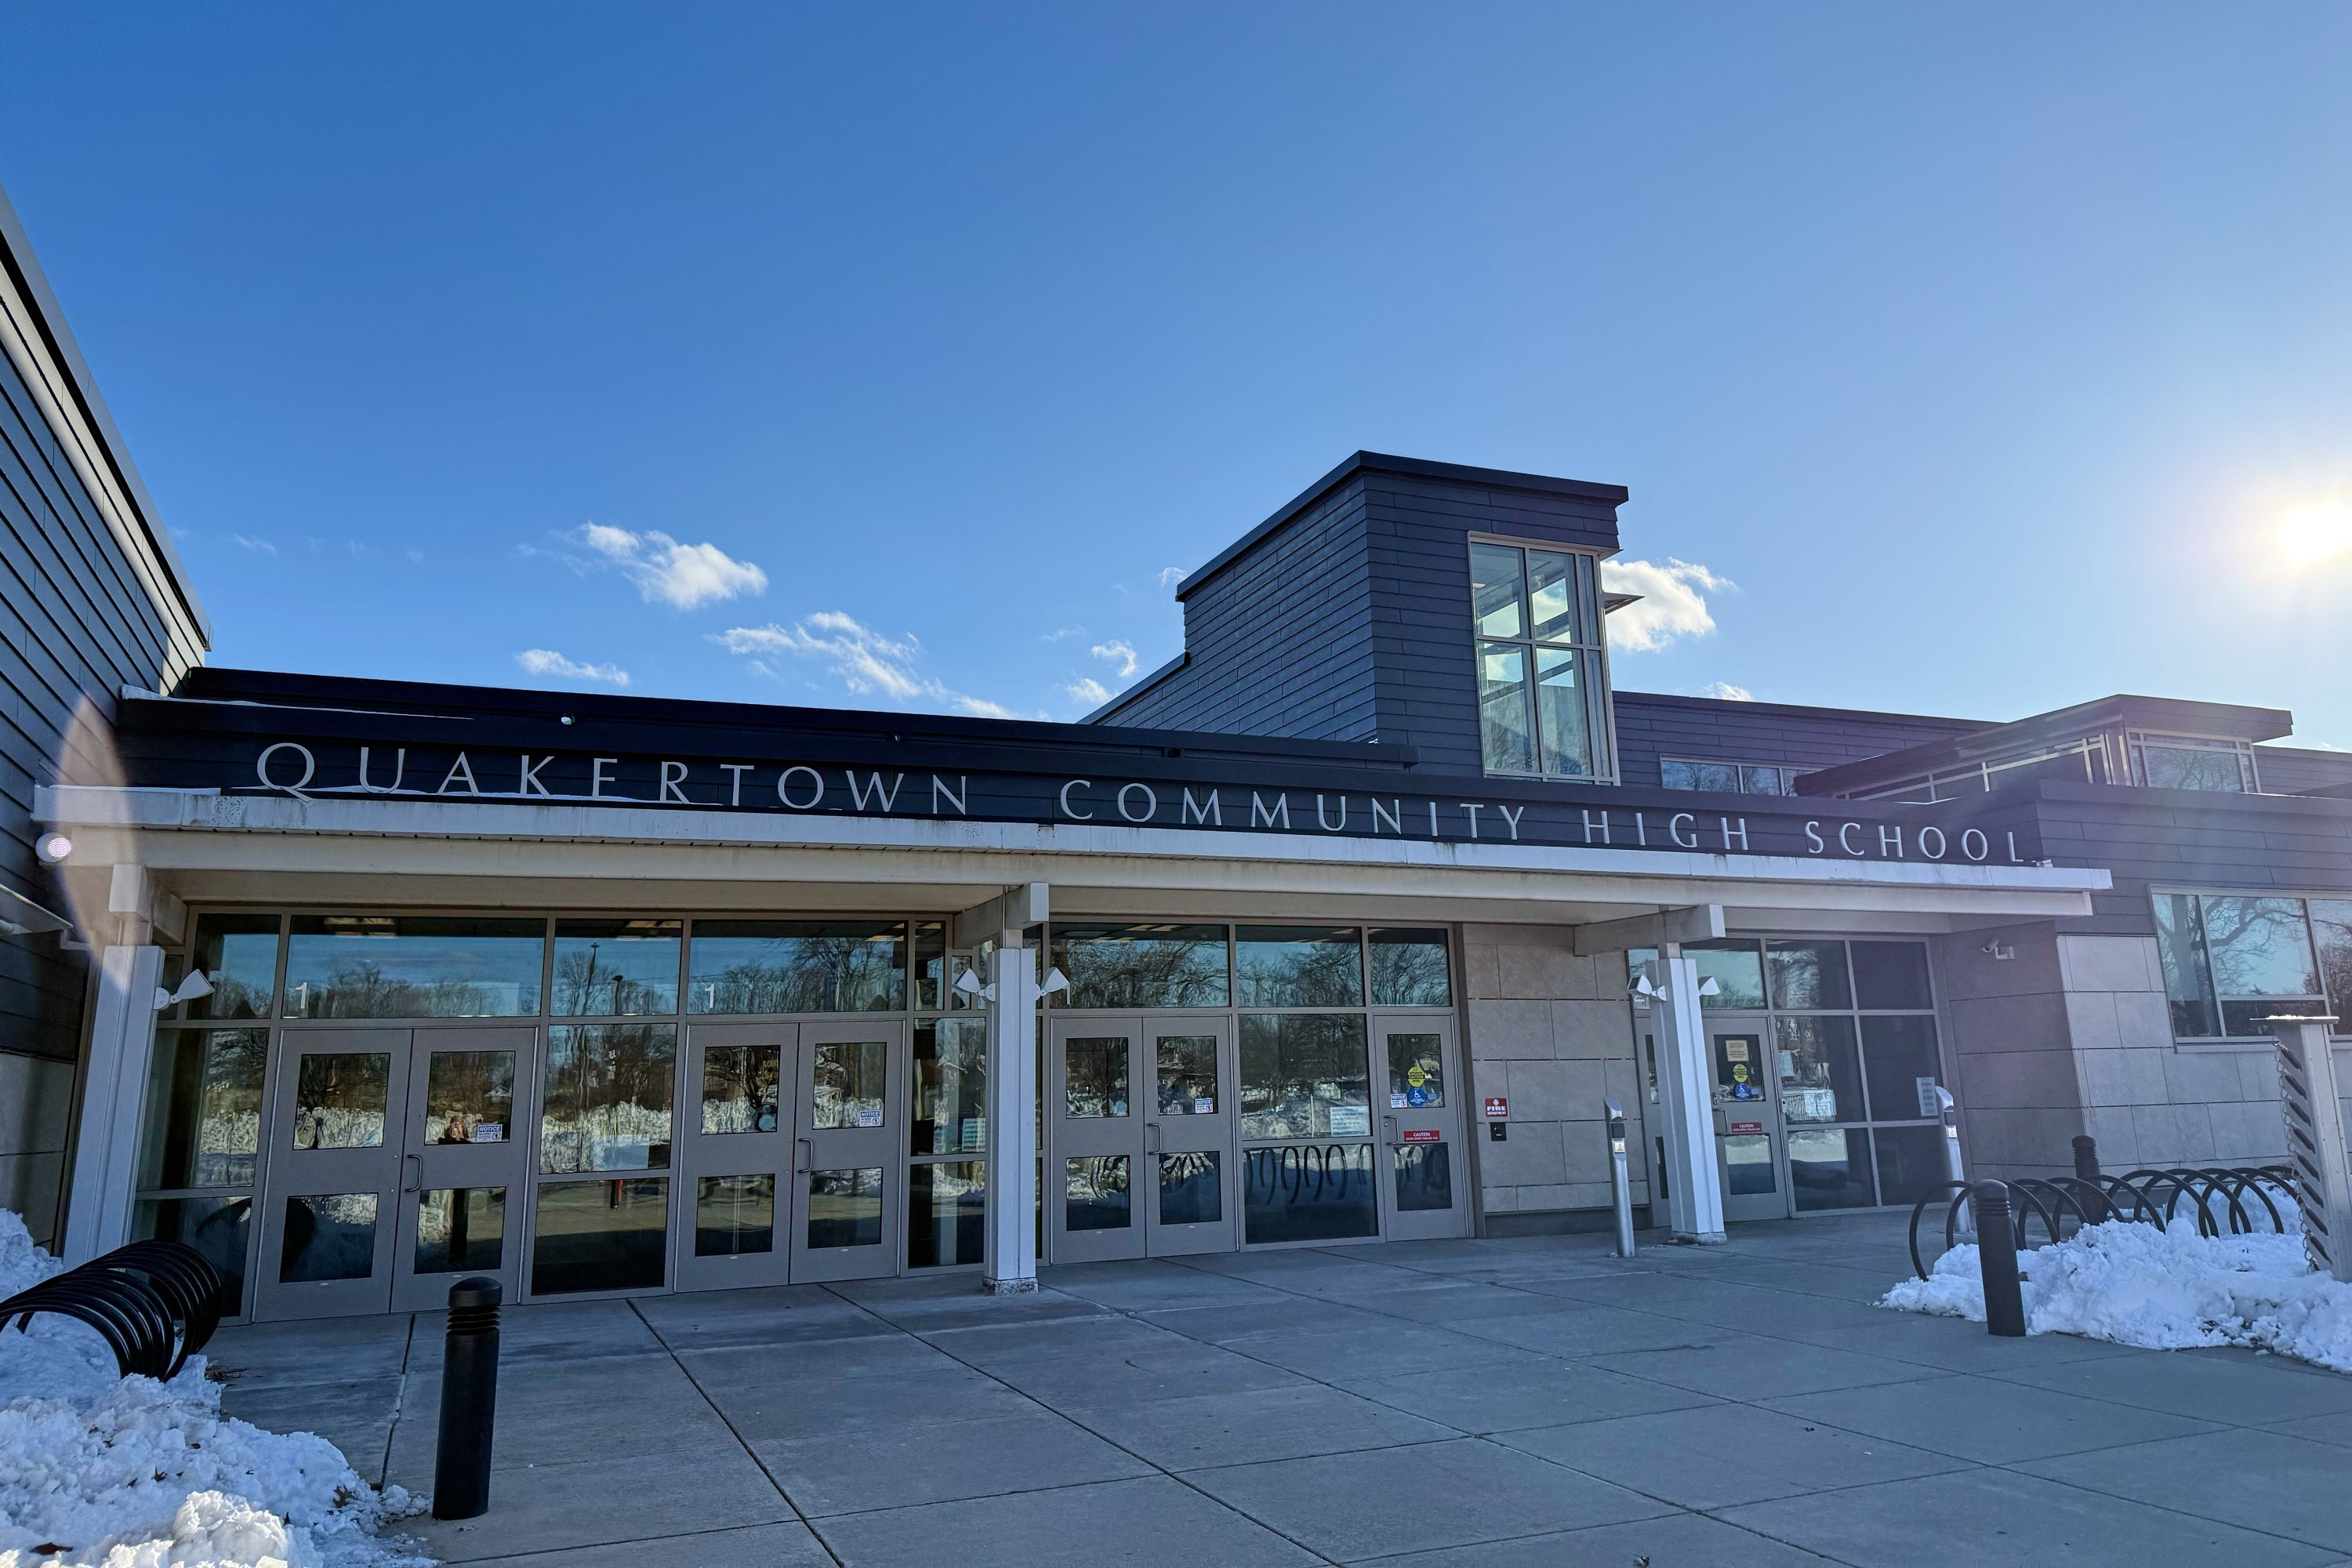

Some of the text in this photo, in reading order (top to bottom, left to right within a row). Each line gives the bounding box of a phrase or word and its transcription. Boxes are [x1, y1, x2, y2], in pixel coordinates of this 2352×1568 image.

[257, 742, 2024, 862] QUAKERTOWN COMMUNITY HIGH SCHOOL
[296, 982, 307, 1009] 1
[705, 983, 714, 1008] 1
